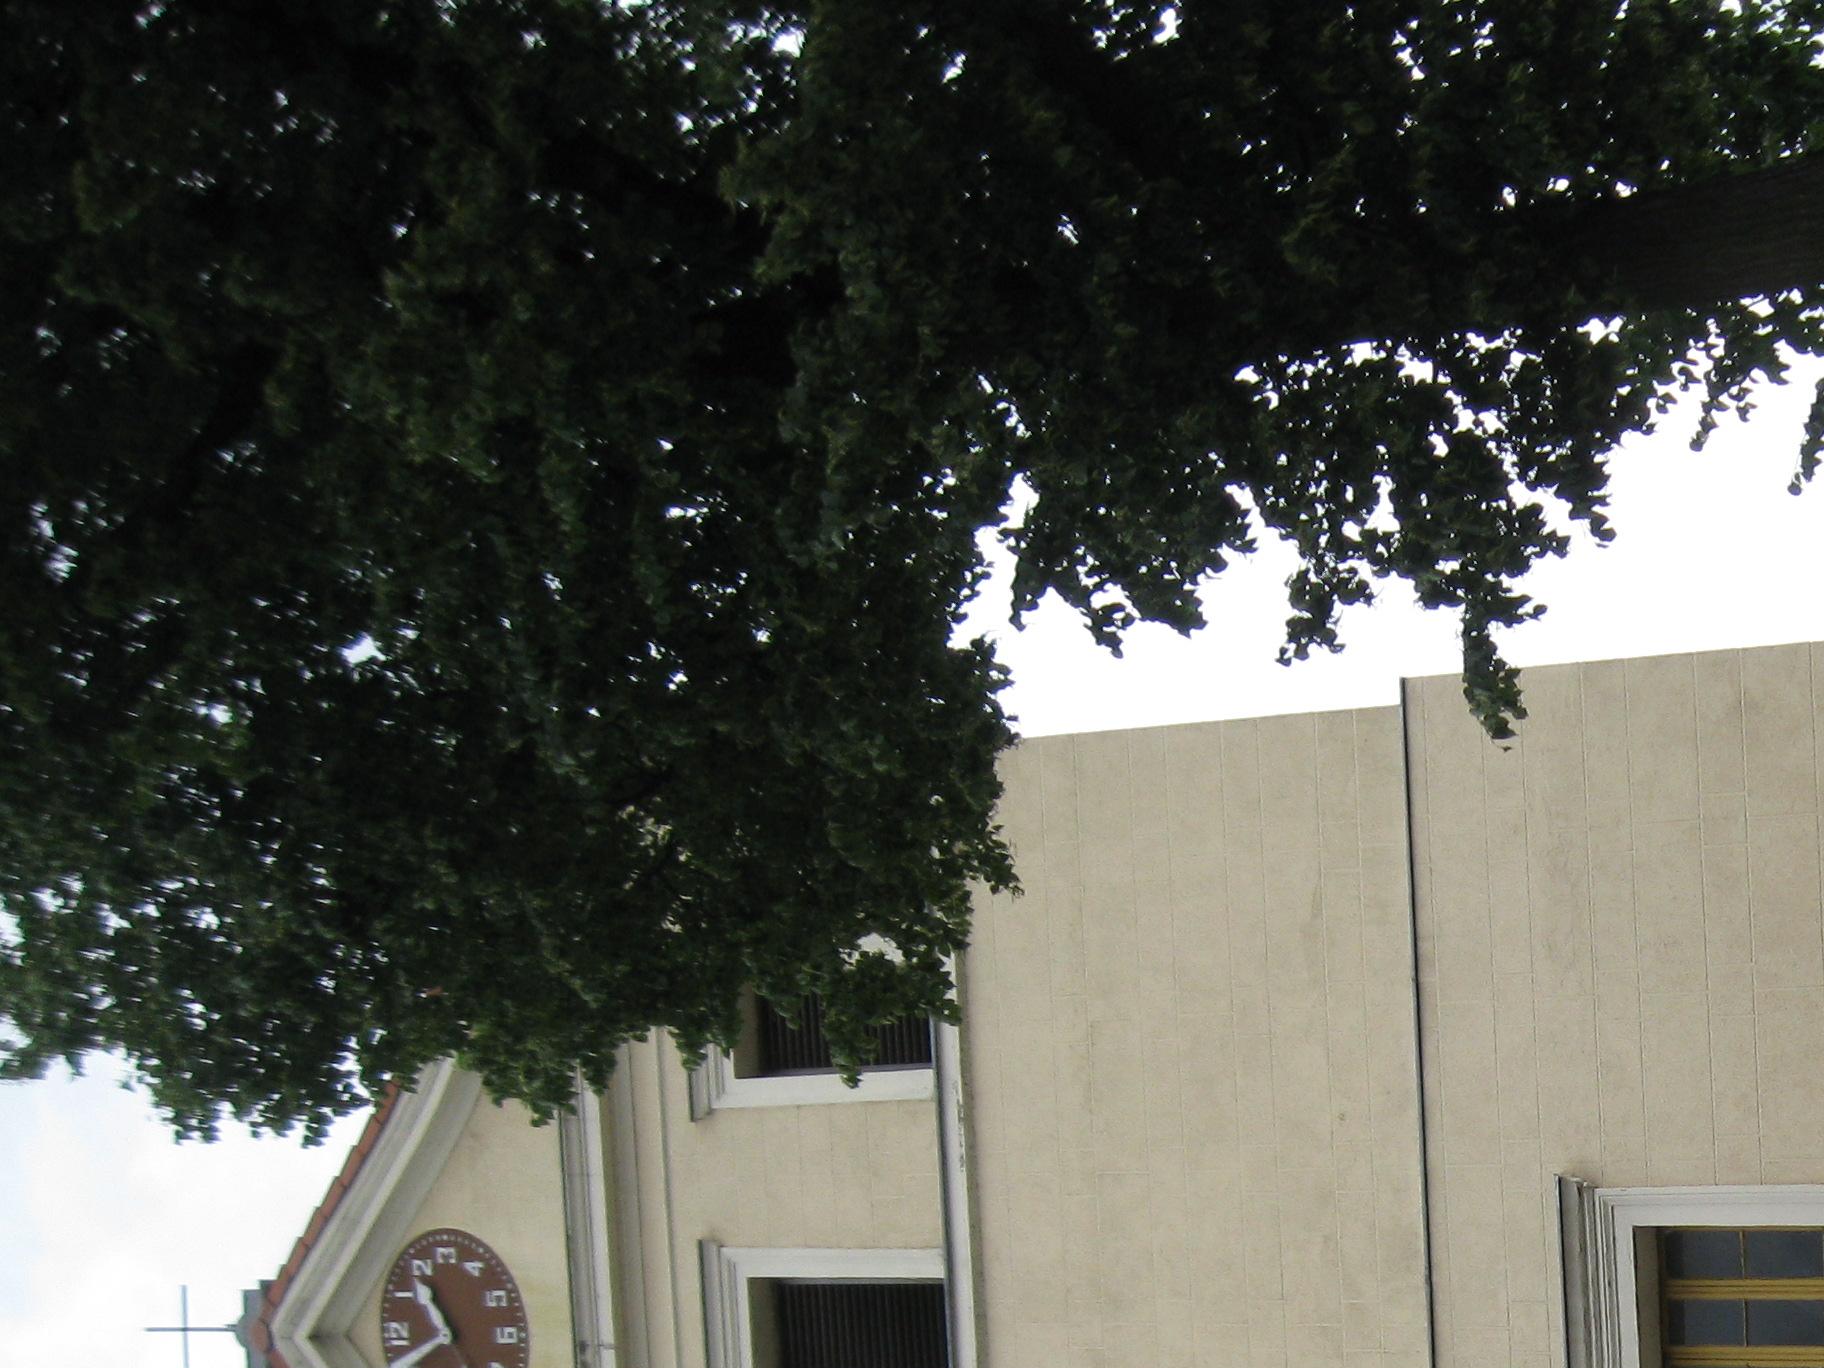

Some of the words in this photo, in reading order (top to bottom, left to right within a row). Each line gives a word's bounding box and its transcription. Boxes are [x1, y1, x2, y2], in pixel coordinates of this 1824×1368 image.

[435, 1247, 456, 1264] 3
[411, 1259, 432, 1276] 2
[462, 1261, 484, 1277] 4
[484, 1290, 507, 1307] 5
[388, 1322, 409, 1346] 12
[496, 1327, 517, 1343] 6
